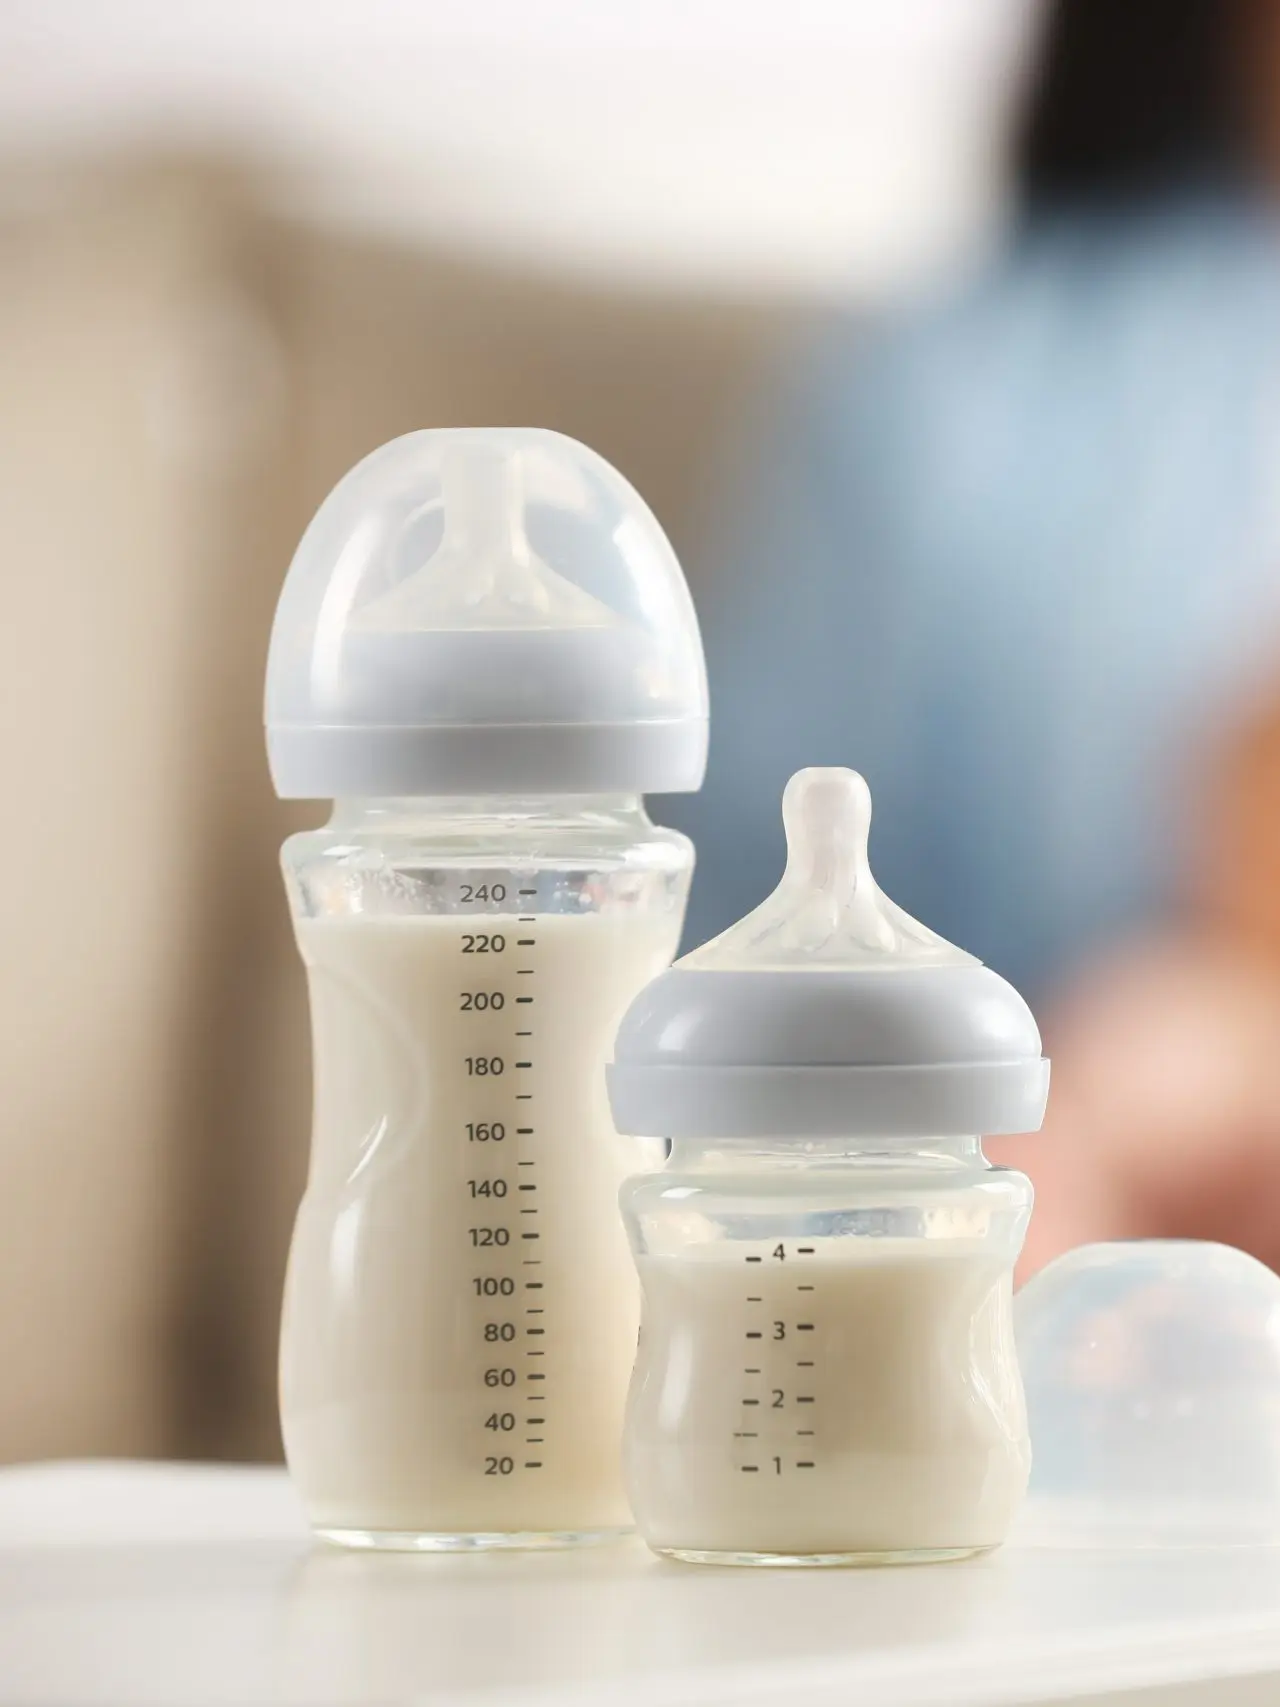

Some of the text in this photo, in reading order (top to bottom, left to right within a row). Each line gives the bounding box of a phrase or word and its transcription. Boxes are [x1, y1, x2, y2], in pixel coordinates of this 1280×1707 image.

[460, 884, 506, 903] 240
[462, 934, 505, 954] 220
[459, 991, 504, 1011] 200
[465, 1056, 505, 1077] 180
[466, 1122, 505, 1142] 160
[467, 1178, 508, 1199] 140
[469, 1227, 510, 1247] 120
[772, 1243, 786, 1261] 4
[473, 1277, 515, 1297] 100
[483, 1322, 516, 1343] 80
[773, 1320, 786, 1341] 3
[484, 1367, 516, 1388] 60
[771, 1389, 785, 1409] 2
[484, 1412, 516, 1432] 40
[484, 1456, 515, 1476] 20
[772, 1456, 782, 1476] 1
